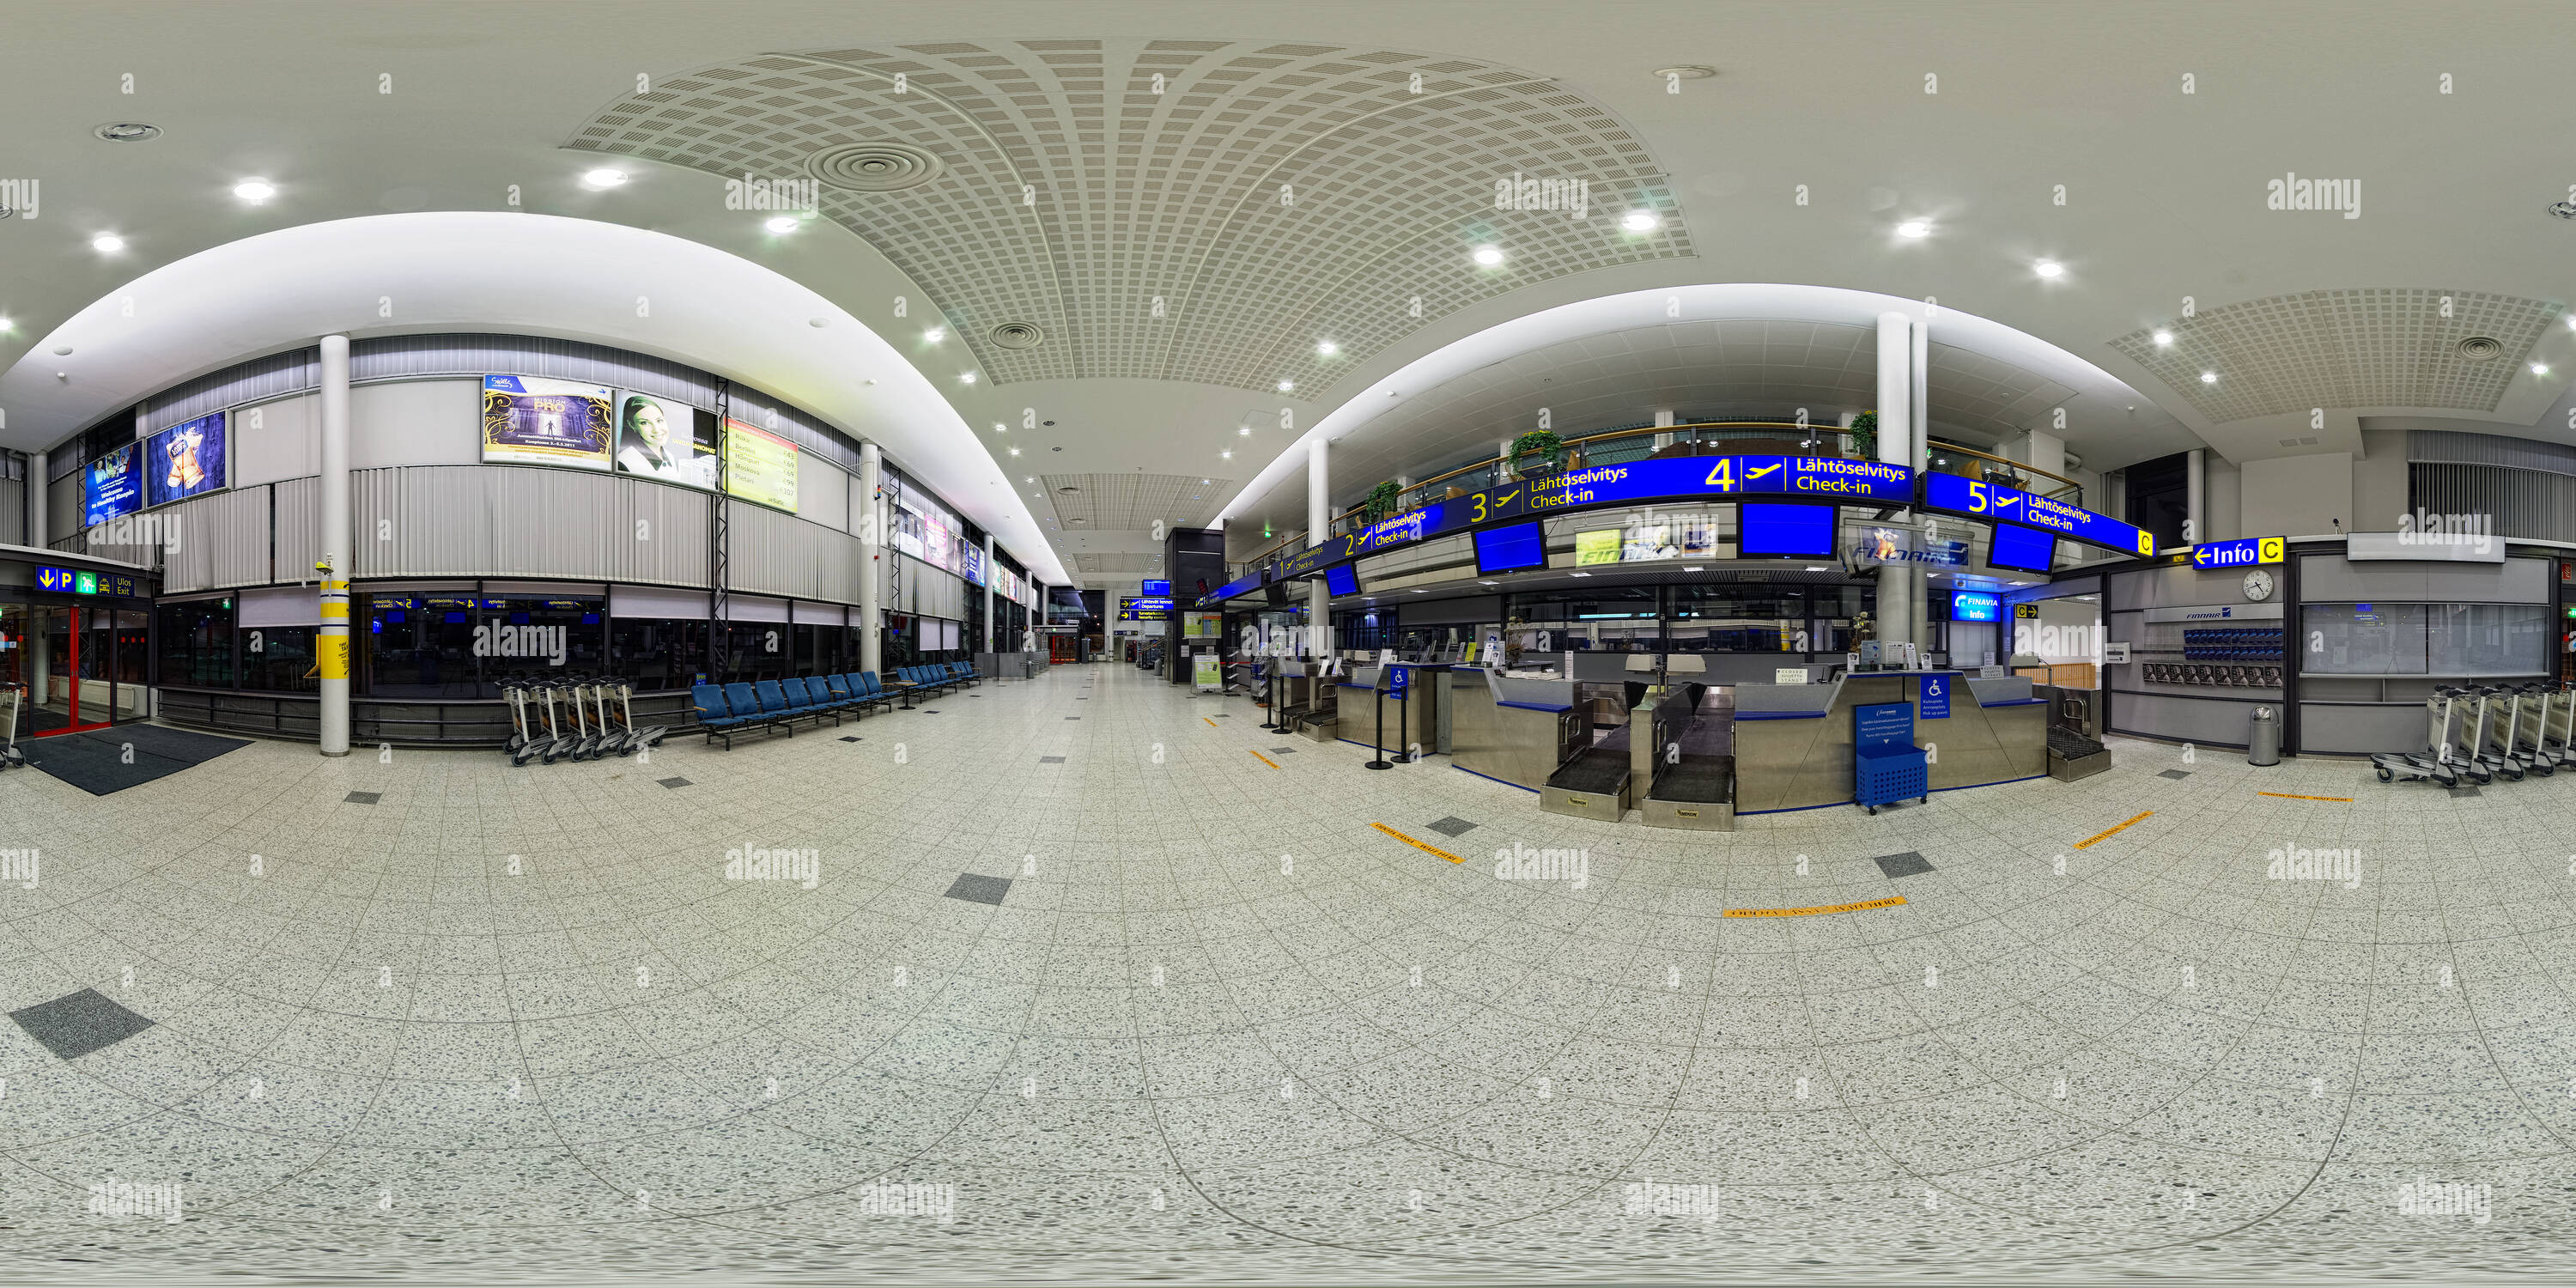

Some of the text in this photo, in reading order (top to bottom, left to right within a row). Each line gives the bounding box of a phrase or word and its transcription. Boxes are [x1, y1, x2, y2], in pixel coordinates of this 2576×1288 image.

[533, 401, 565, 412] PRO
[1705, 459, 1735, 491] 4
[1796, 458, 1905, 482] Lähtöselvitys
[1531, 467, 1628, 493] Lähtöselvitys
[1796, 476, 1871, 494] Check-in
[97, 496, 115, 507] Healthy
[116, 489, 135, 500] Kuopio
[101, 487, 123, 499] Welcome
[1530, 488, 1594, 508] Check-in
[1969, 481, 1987, 512] 5
[1471, 494, 1487, 523] 3
[2028, 495, 2091, 523] Lähtöselvitys
[1376, 511, 1426, 533] Lähtöselvitys
[2028, 510, 2073, 531] Check-in
[1345, 534, 1354, 556] 2
[1376, 529, 1408, 546] Check-in
[2142, 535, 2150, 551] C
[2214, 544, 2254, 564] Info
[2263, 541, 2279, 559] C
[1280, 561, 1284, 577] 1
[1296, 559, 1314, 571] Check-in
[62, 573, 71, 587] P
[117, 578, 131, 586] Ulos
[117, 587, 130, 596] Exit
[1968, 598, 1998, 606] FINAVIA
[1970, 611, 1985, 619] Info
[2019, 607, 2026, 616] C
